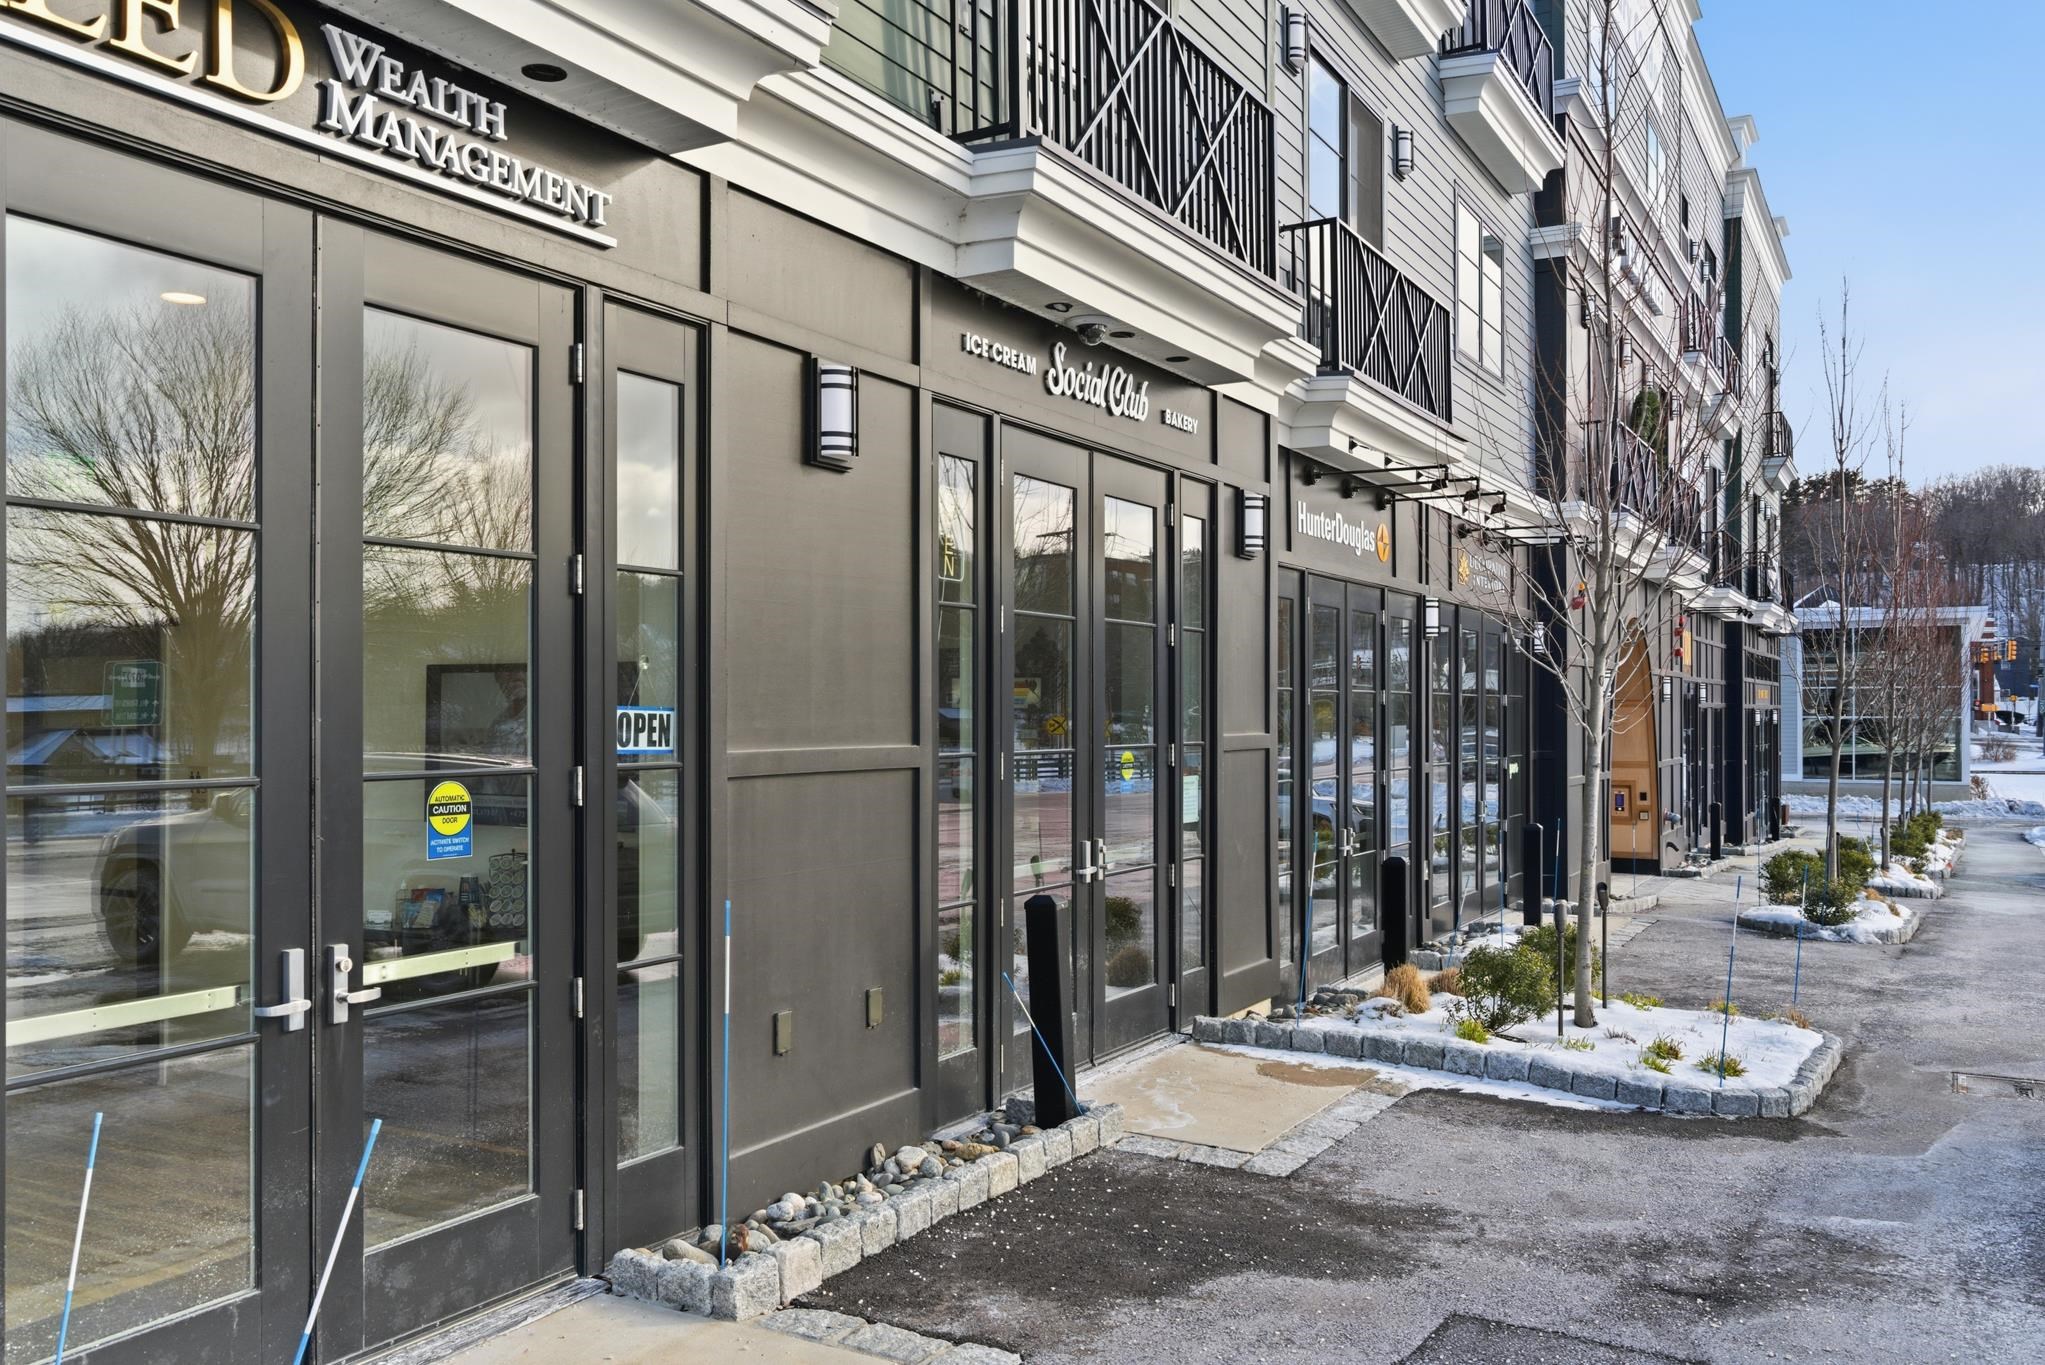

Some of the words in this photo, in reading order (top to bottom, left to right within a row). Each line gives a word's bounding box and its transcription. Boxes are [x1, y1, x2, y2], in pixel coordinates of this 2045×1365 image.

[320, 23, 508, 141] WEALTH
[320, 78, 613, 227] MANAGEMENT
[965, 331, 989, 358] ICE
[992, 341, 1037, 376] CREAM
[1047, 341, 1109, 408] Social
[1109, 366, 1150, 422] Club
[1164, 408, 1199, 434] BAKERY
[617, 711, 671, 748] OPEN
[432, 804, 467, 814] CAUTION
[434, 794, 466, 802] AUTOMATIC
